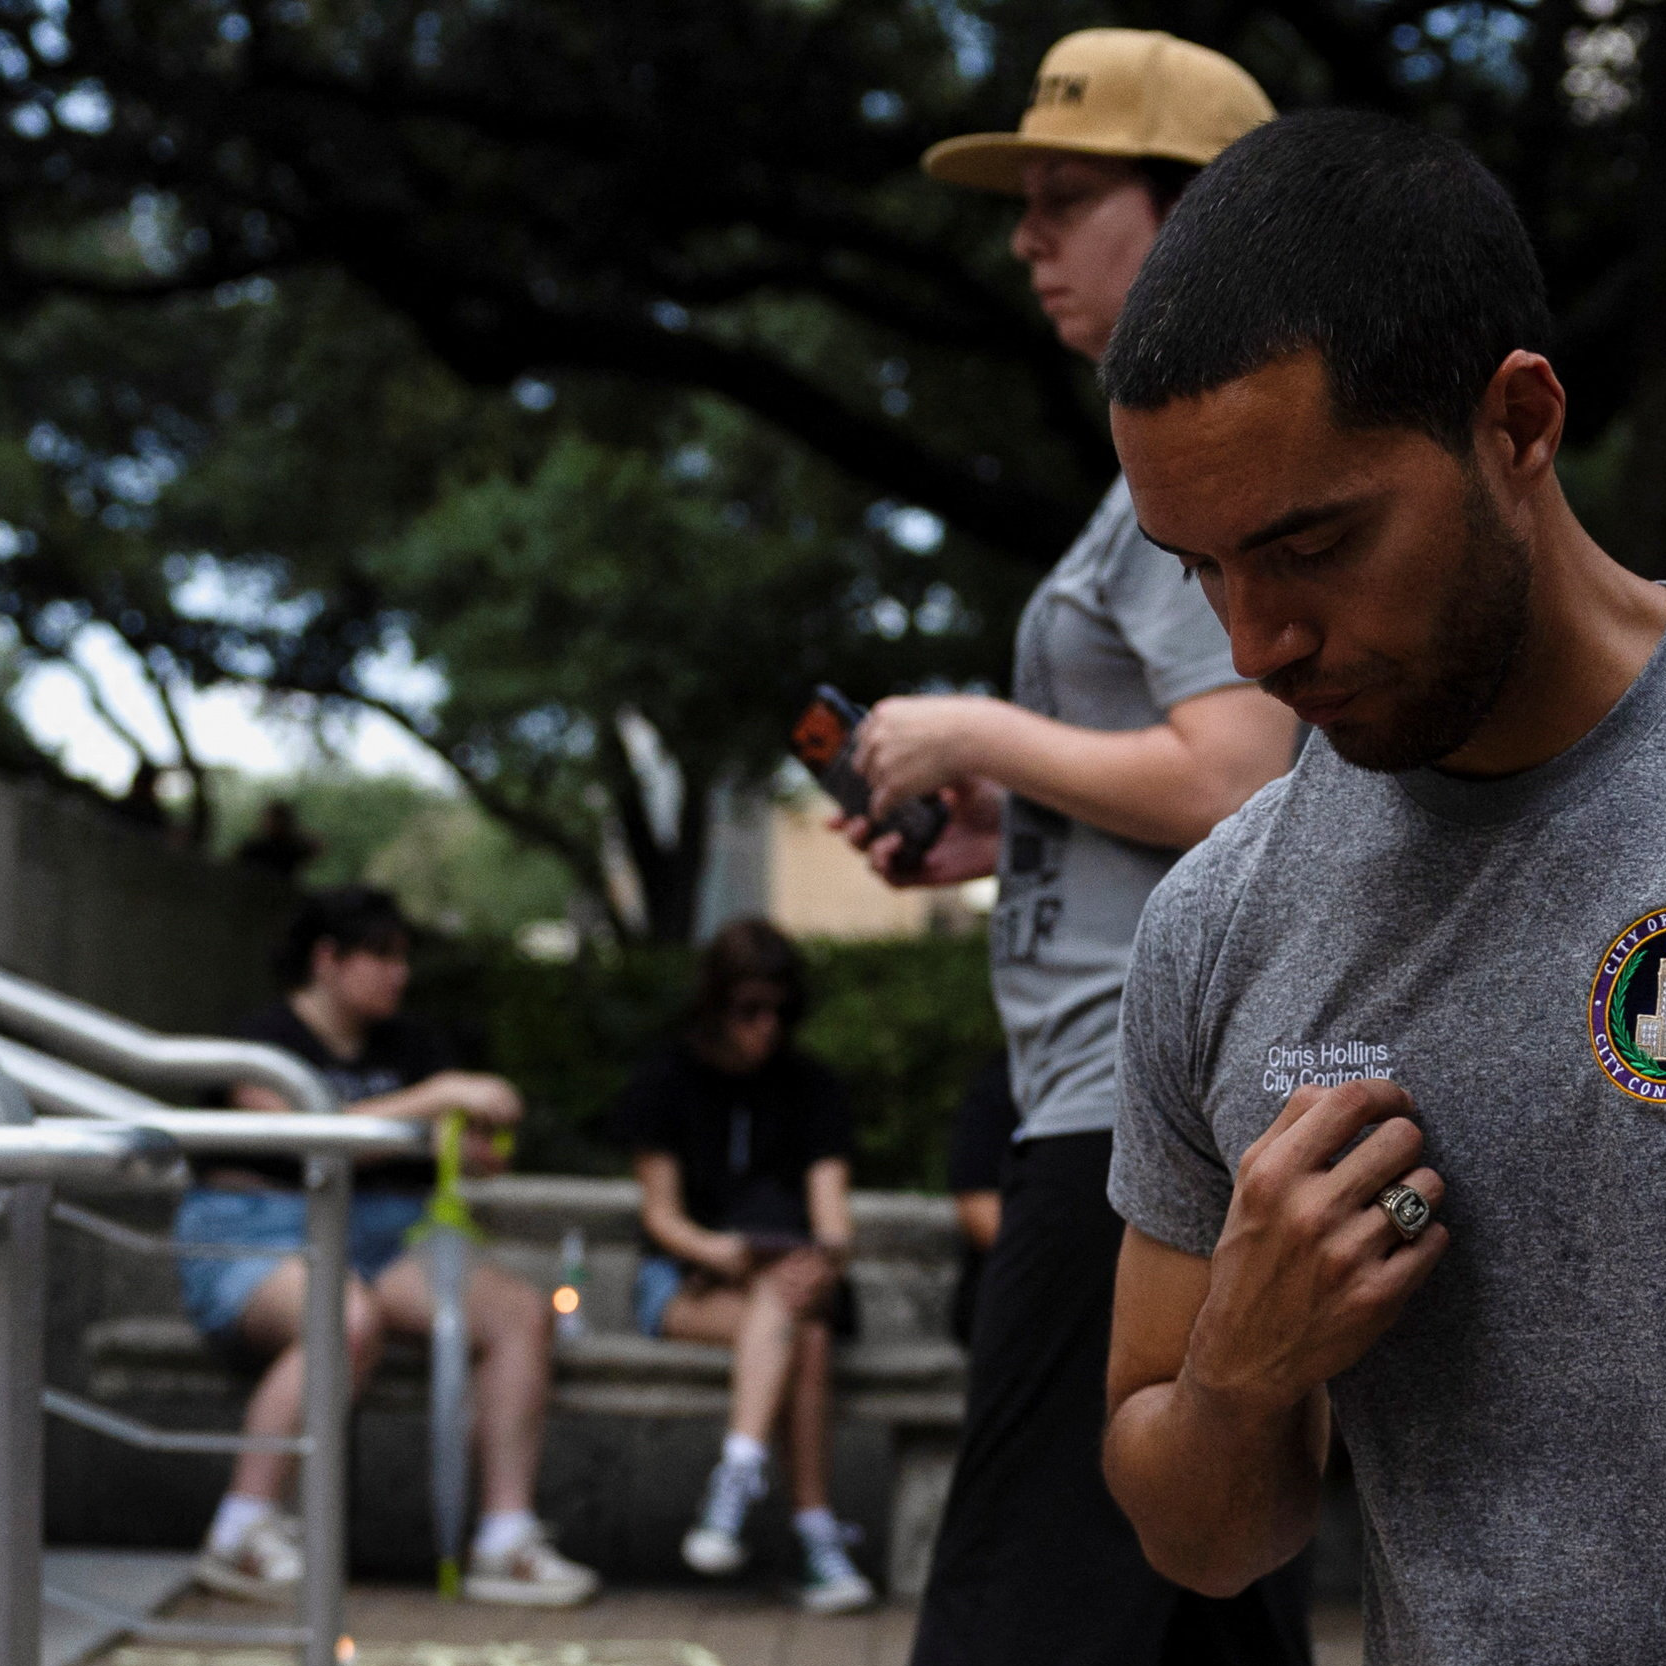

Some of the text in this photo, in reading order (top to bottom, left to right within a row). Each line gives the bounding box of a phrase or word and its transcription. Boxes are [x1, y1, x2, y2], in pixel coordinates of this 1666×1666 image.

[1604, 929, 1641, 975] CITY
[1268, 1041, 1388, 1067] Chris Hollins
[1595, 1033, 1625, 1077] CITY
[1263, 1069, 1295, 1097] City
